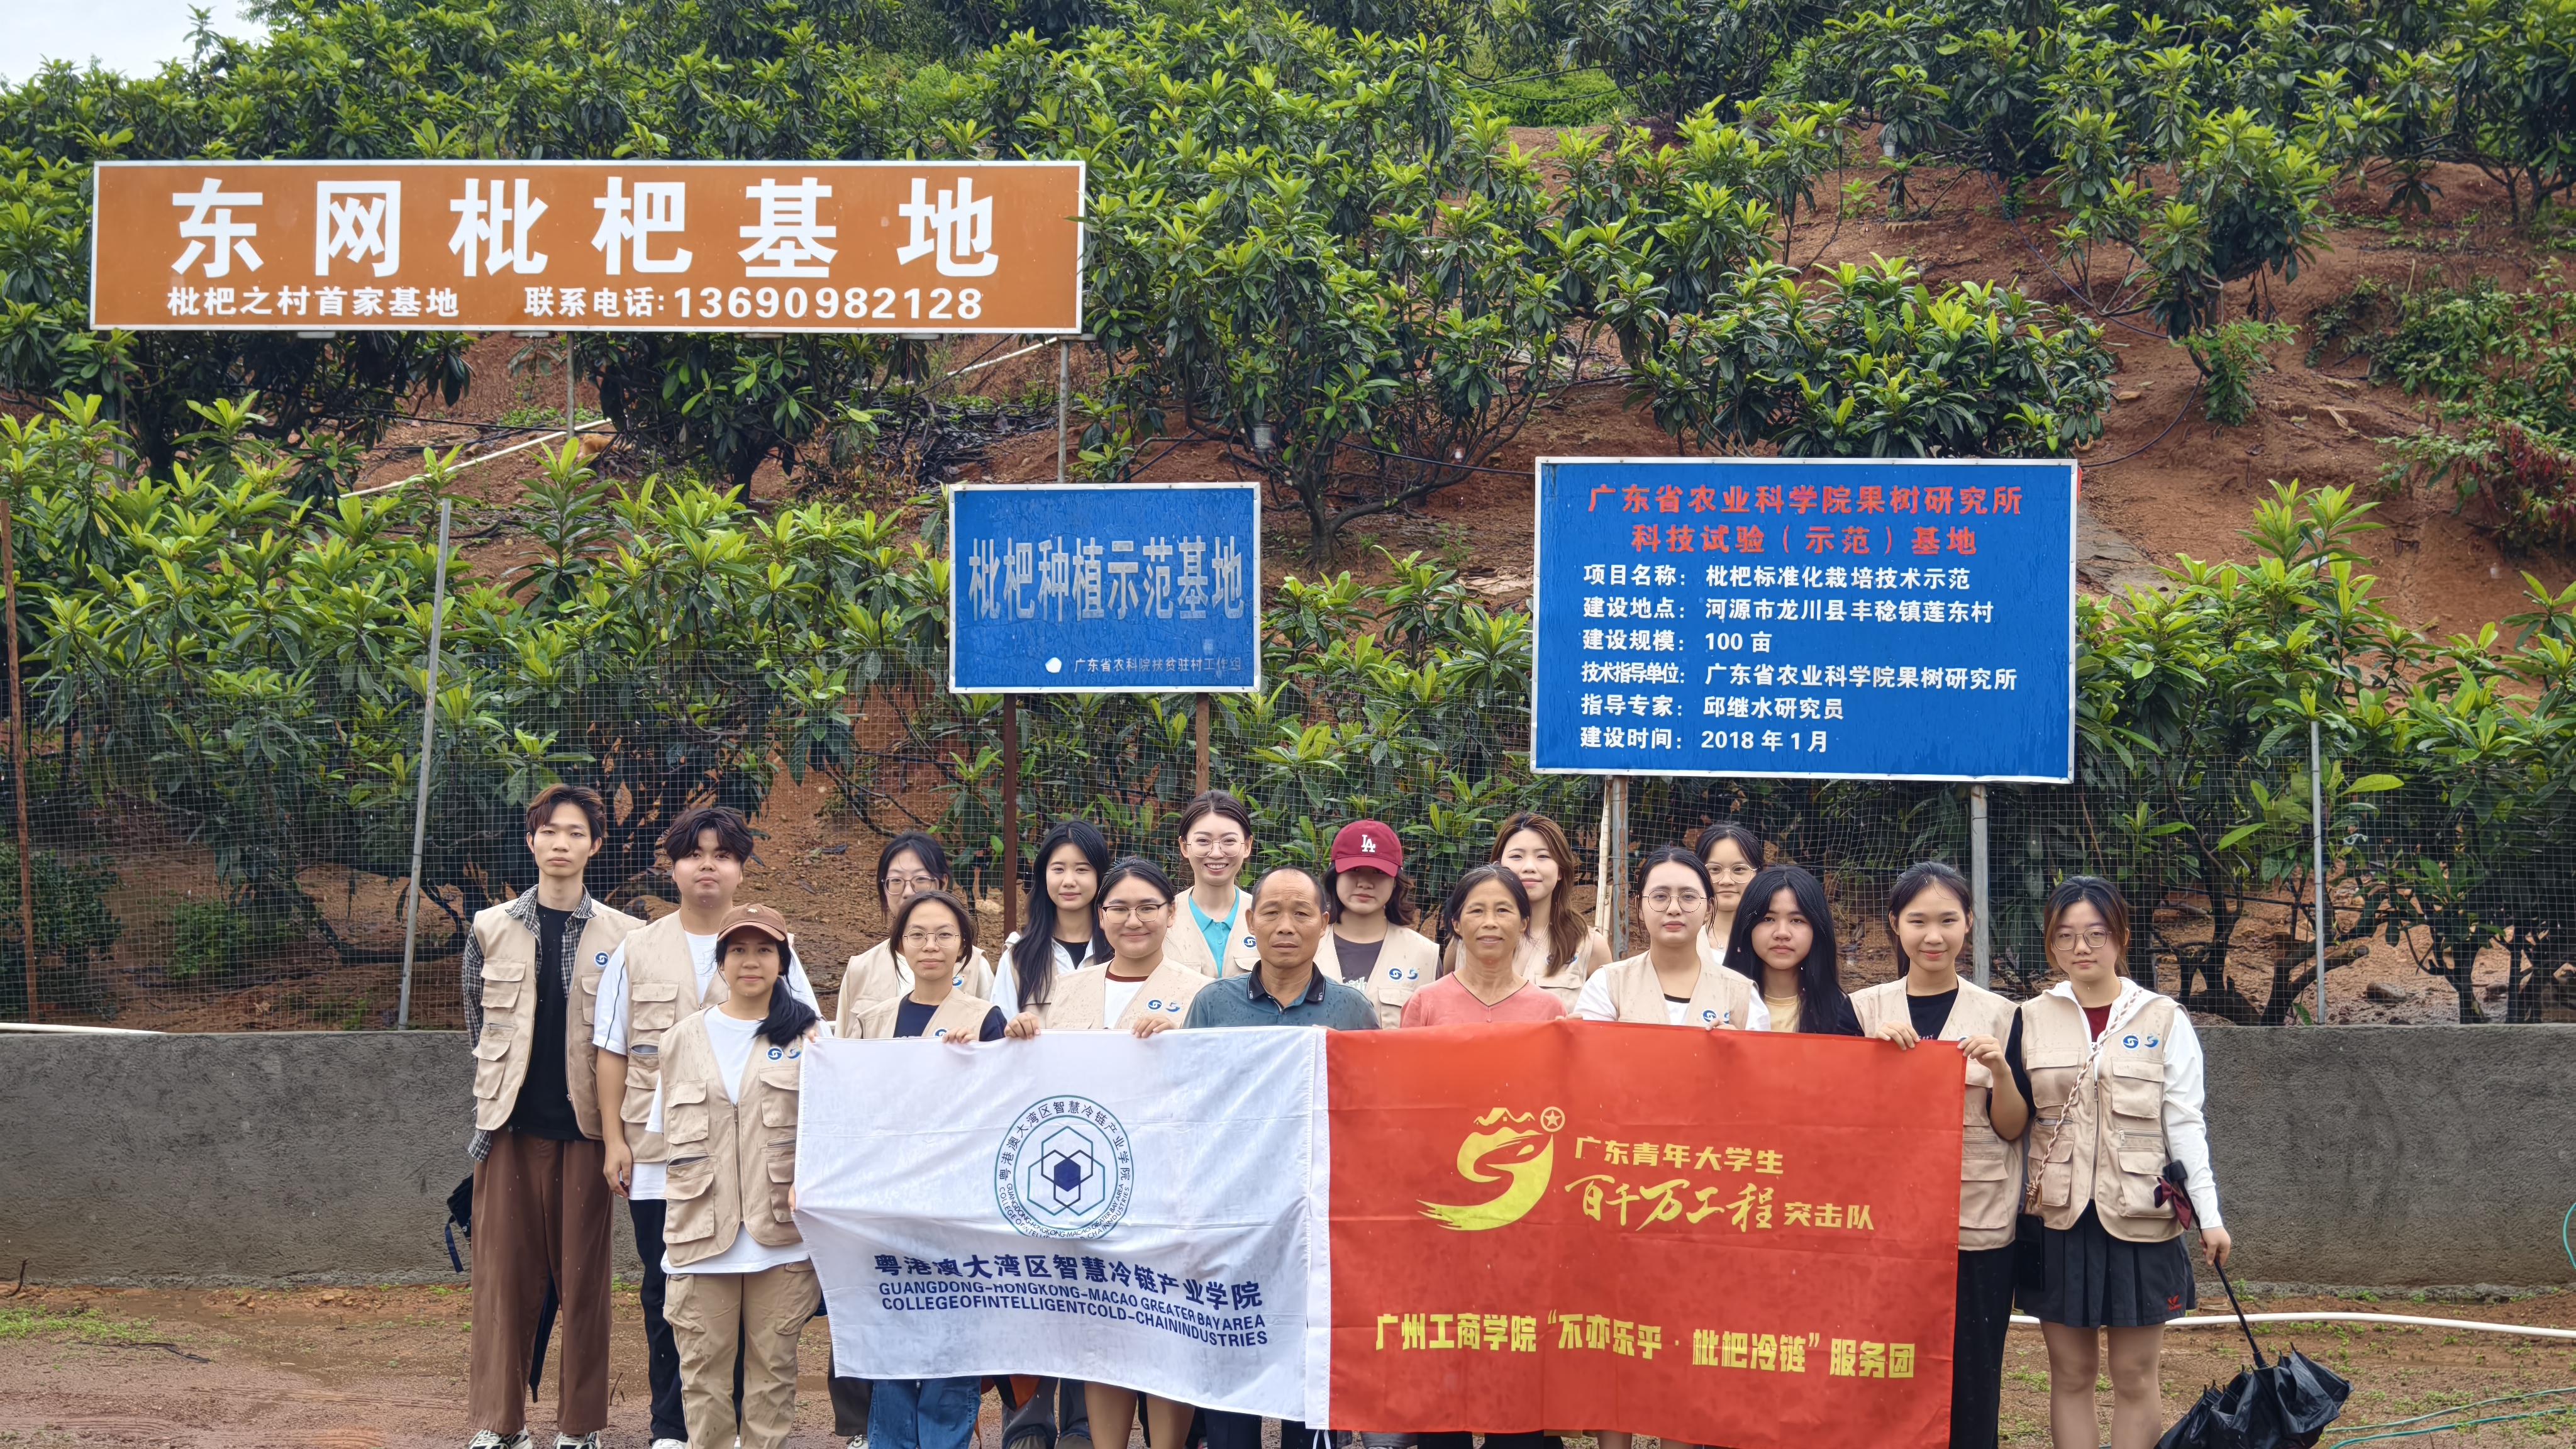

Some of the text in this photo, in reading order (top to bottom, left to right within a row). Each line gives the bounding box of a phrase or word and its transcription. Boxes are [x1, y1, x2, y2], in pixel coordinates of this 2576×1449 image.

[170, 176, 999, 277] 东网枇杷基地
[167, 285, 459, 318] 枇杷之村首家基地
[1589, 484, 2022, 515] 广东省农业科学院果树研究所
[969, 535, 1245, 623] 枇杷种植示范基地
[1706, 565, 1970, 590] 枇杷标准化栽培技术示范
[1706, 598, 1994, 623] 河源市龙川县丰稔镇莲东村
[1705, 662, 2017, 691] 广东省农业科学院果树研究所
[1703, 696, 1844, 720] 邱继水研究员
[1360, 834, 1376, 853] LA
[999, 1100, 1130, 1181] 粤港澳大湾区智慧冷链产业学院
[1574, 1136, 1784, 1175] 广东青年大学生
[874, 1254, 1263, 1311] 粤港澳大湾区智慧冷链产业学院
